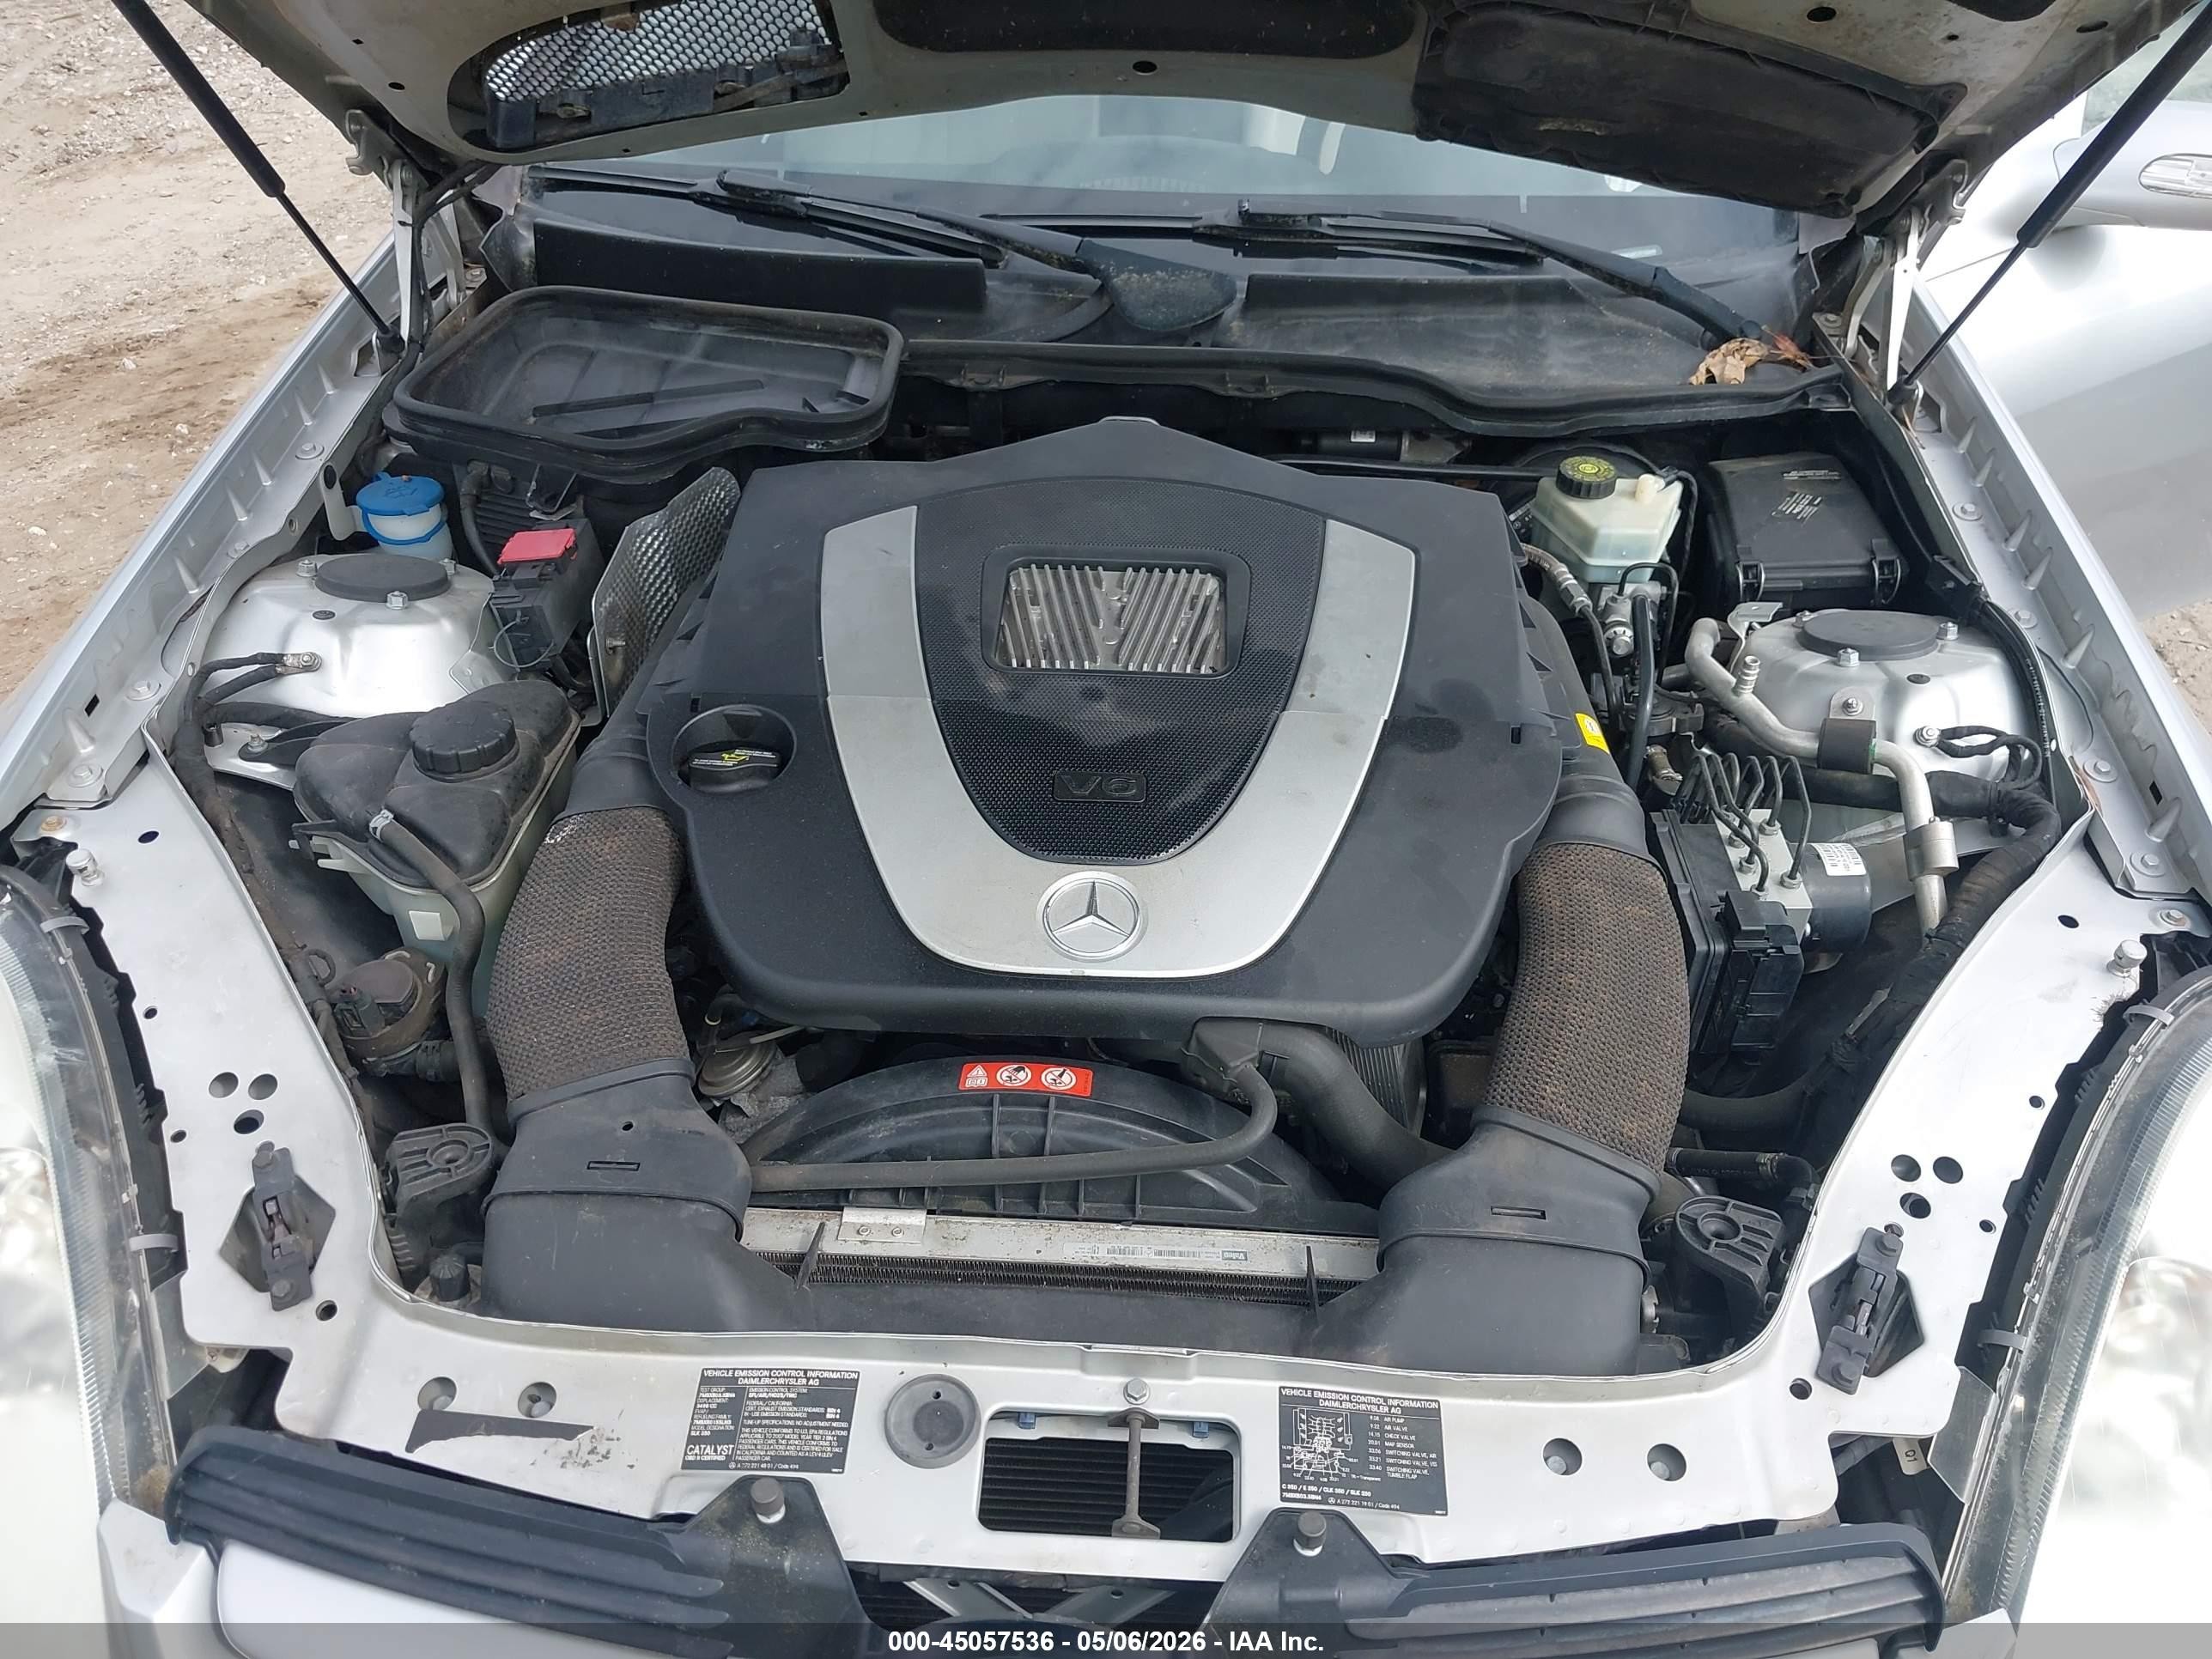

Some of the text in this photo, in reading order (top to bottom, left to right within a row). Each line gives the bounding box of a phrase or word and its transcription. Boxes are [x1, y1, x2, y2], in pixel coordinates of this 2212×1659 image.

[1060, 775, 1136, 797] V6
[807, 1370, 858, 1379] INFORMATION
[1281, 1388, 1439, 1408] VEHICLE EMISSION CONTROL INFORMATION
[1319, 1400, 1389, 1414] DAIMLERCHRYSLER
[687, 1444, 734, 1455] CATALYST
